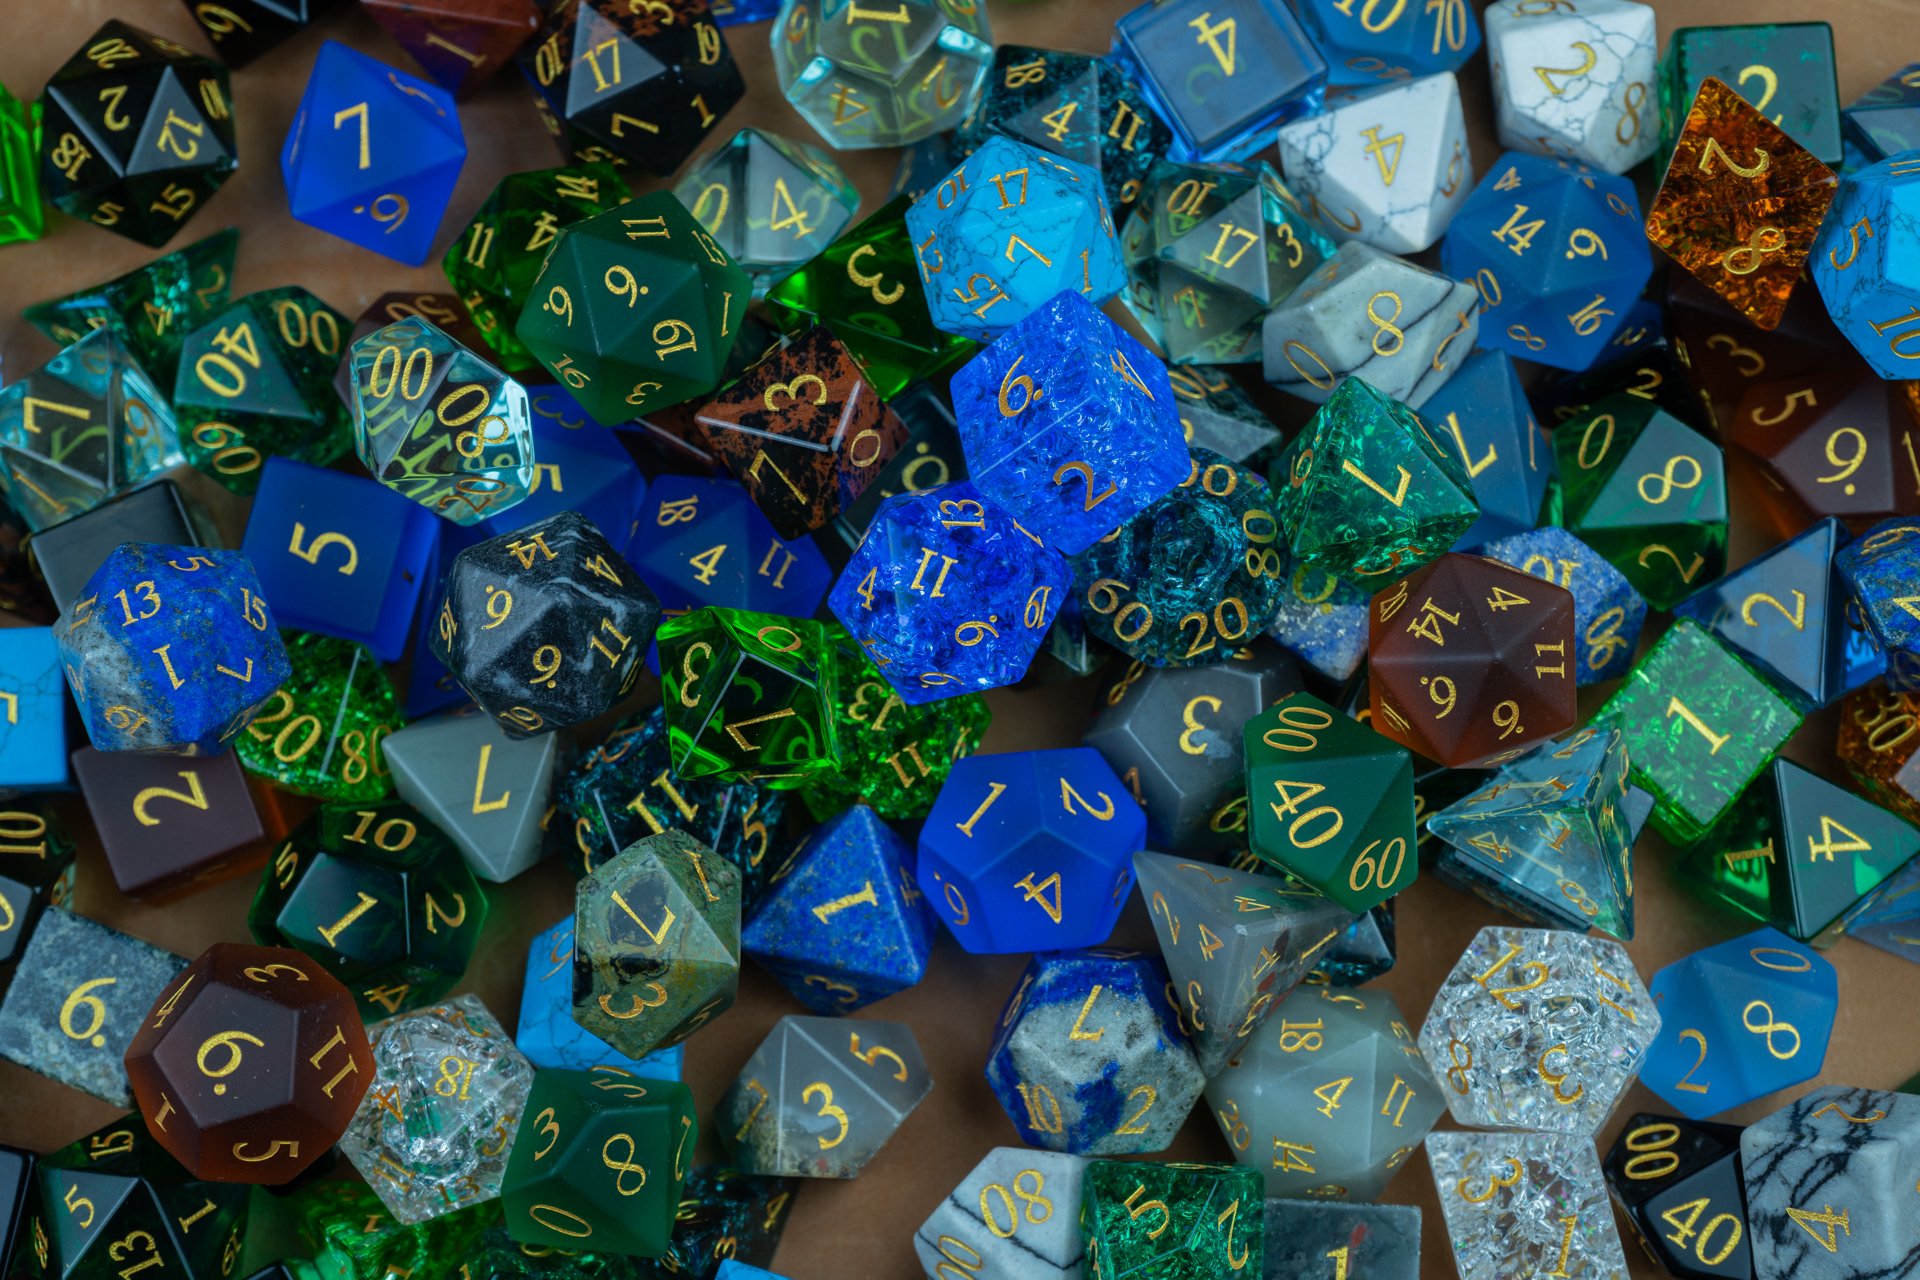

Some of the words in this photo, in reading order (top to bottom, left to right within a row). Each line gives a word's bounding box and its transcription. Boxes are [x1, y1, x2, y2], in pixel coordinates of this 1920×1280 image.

[426, 33, 487, 67] 1
[536, 32, 565, 86] 10
[581, 37, 622, 93] 17
[1188, 12, 1236, 76] 4
[1005, 57, 1047, 88] 18
[1533, 42, 1597, 95] 2
[99, 85, 130, 130] 2
[611, 113, 659, 137] 7
[690, 94, 715, 128] 1
[1042, 102, 1079, 142] 4
[1108, 100, 1145, 151] 11
[1615, 81, 1646, 145] 8
[52, 133, 92, 181] 18
[157, 109, 205, 160] 12
[334, 102, 370, 169] 7
[1360, 125, 1405, 187] 4
[1699, 137, 1769, 177] 2
[150, 183, 195, 220] 15
[556, 175, 599, 202] 14
[770, 177, 817, 238] 4
[936, 166, 971, 210] 10
[989, 167, 1029, 210] 17
[92, 202, 124, 225] 5
[622, 216, 670, 240] 11
[1491, 205, 1546, 255] 14
[464, 223, 494, 269] 11
[692, 229, 728, 267] 13
[916, 230, 943, 283] 12
[1006, 234, 1052, 268] 7
[1205, 224, 1259, 269] 17
[1277, 224, 1303, 268] 3
[1723, 227, 1785, 274] 8
[1830, 216, 1874, 270] 5
[847, 244, 905, 304] 3
[1079, 248, 1093, 294] 1
[721, 291, 732, 336] 1
[953, 272, 1010, 319] 15
[1568, 295, 1614, 335] 16
[278, 302, 339, 355] 00
[1368, 291, 1404, 356] 8
[1507, 324, 1547, 350] 8
[195, 322, 261, 397] 40
[371, 346, 433, 400] 00
[551, 353, 591, 389] 16
[1109, 349, 1155, 400] 4
[1284, 340, 1335, 389] 0
[1707, 334, 1765, 376] 3
[626, 382, 662, 405] 3
[764, 375, 827, 413] 3
[1626, 368, 1662, 399] 2
[24, 397, 90, 433] 7
[1752, 389, 1817, 426] 5
[192, 422, 261, 474] 60
[851, 429, 880, 467] 0
[1445, 412, 1497, 478] 7
[1578, 414, 1615, 469] 0
[13, 472, 66, 513] 1
[750, 449, 806, 505] 7
[1053, 461, 1117, 512] 2
[1343, 458, 1412, 507] 7
[1638, 455, 1702, 504] 8
[657, 495, 699, 527] 18
[939, 500, 986, 531] 13
[1013, 518, 1044, 548] 1
[169, 556, 215, 571] 5
[288, 522, 358, 575] 5
[506, 532, 558, 571] 14
[586, 554, 622, 587] 4
[689, 544, 728, 586] 4
[758, 538, 797, 589] 11
[1638, 544, 1704, 584] 2
[857, 567, 877, 610] 4
[911, 547, 958, 598] 11
[114, 580, 161, 627] 13
[240, 588, 267, 631] 15
[1406, 597, 1460, 646] 14
[1487, 587, 1530, 612] 4
[1742, 589, 1806, 631] 2
[590, 617, 632, 669] 11
[757, 626, 801, 652] 0
[1179, 597, 1248, 659] 20
[152, 644, 185, 690] 1
[217, 657, 253, 683] 7
[680, 642, 712, 708] 3
[1535, 640, 1565, 679] 11
[724, 706, 796, 752] 7
[1179, 696, 1222, 755] 3
[1264, 707, 1332, 752] 00
[1667, 696, 1731, 755] 1
[473, 744, 510, 814] 7
[886, 741, 931, 788] 11
[133, 771, 209, 827] 2
[956, 782, 1006, 838] 1
[1060, 777, 1114, 821] 2
[1270, 780, 1343, 849] 40
[342, 809, 418, 852] 10
[1809, 816, 1871, 862] 4
[276, 842, 298, 889] 5
[1350, 837, 1405, 891] 60
[1725, 838, 1775, 872] 1
[317, 891, 377, 947] 1
[425, 892, 465, 934] 2
[611, 890, 675, 945] 7
[812, 880, 878, 924] 1
[1015, 872, 1061, 924] 4
[1154, 892, 1180, 945] 2
[244, 965, 309, 982] 3
[1473, 947, 1549, 1009] 12
[1750, 948, 1811, 971] 0
[153, 974, 194, 1028] 4
[364, 984, 410, 1014] 4
[600, 982, 668, 1019] 3
[805, 976, 858, 1003] 3
[1069, 985, 1105, 1040] 7
[1593, 959, 1637, 1024] 11
[1279, 1018, 1324, 1053] 18
[1743, 1001, 1800, 1059] 8
[309, 1025, 358, 1098] 11
[435, 1056, 480, 1100] 18
[851, 1033, 908, 1081] 5
[1447, 1039, 1473, 1095] 8
[1539, 1044, 1583, 1103] 3
[1675, 1028, 1710, 1094] 2
[802, 1082, 848, 1150] 3
[1017, 1083, 1062, 1134] 10
[1115, 1086, 1156, 1134] 2
[1314, 1076, 1353, 1118] 4
[1380, 1075, 1416, 1126] 11
[1812, 1103, 1885, 1122] 2
[91, 1130, 135, 1160] 15
[233, 1140, 298, 1162] 5
[533, 1108, 559, 1161] 3
[1273, 1135, 1315, 1174] 14
[1625, 1124, 1681, 1179] 00
[374, 1154, 415, 1191] 11
[602, 1133, 646, 1196] 8
[1458, 1158, 1524, 1202] 3
[64, 1185, 94, 1228] 5
[179, 1199, 218, 1234] 1
[530, 1205, 592, 1236] 0
[1124, 1184, 1169, 1240] 5
[1786, 1205, 1849, 1252] 4
[1218, 1198, 1249, 1270] 2
[1552, 1215, 1577, 1278] 1
[1662, 1197, 1742, 1265] 40
[109, 1231, 164, 1280] 13
